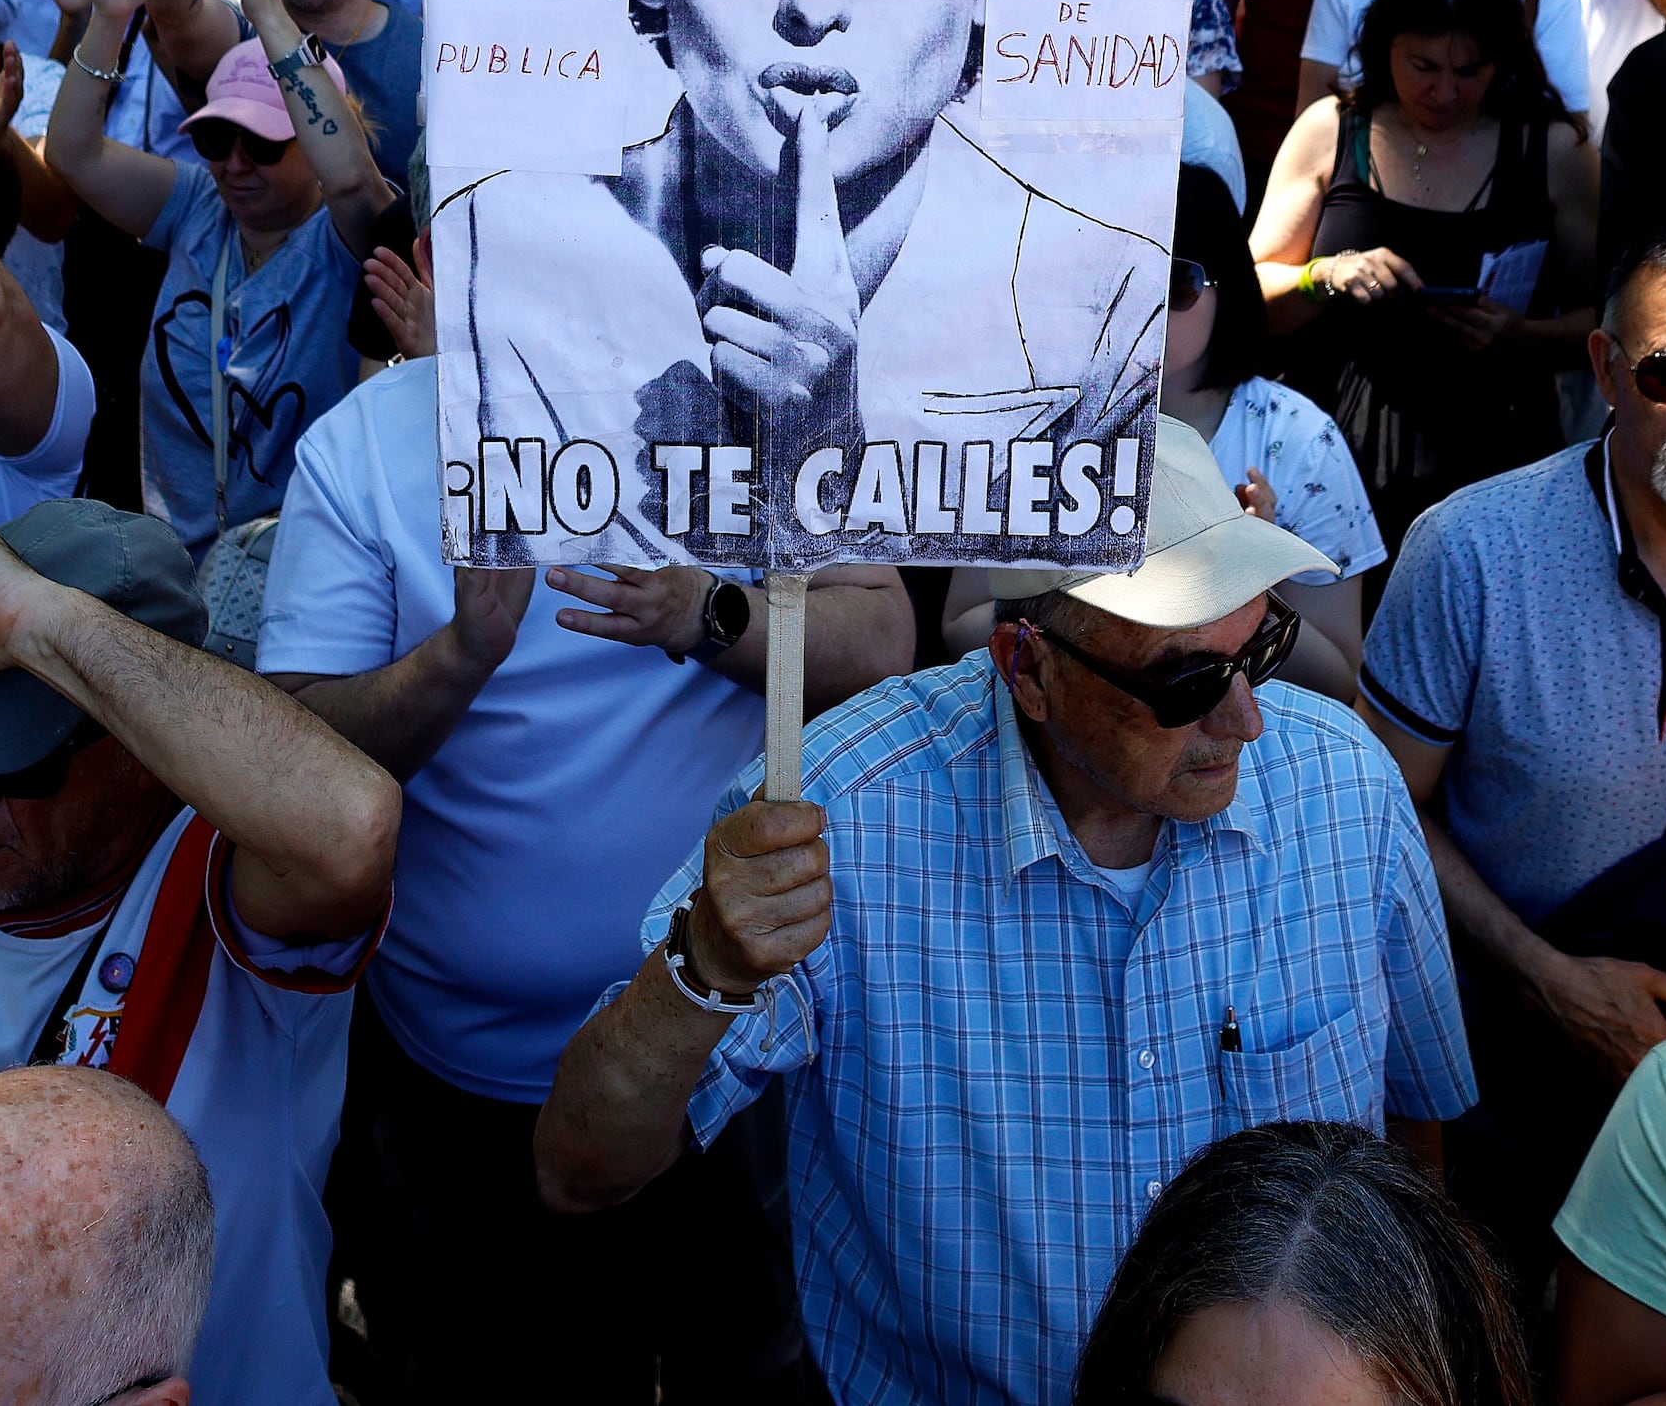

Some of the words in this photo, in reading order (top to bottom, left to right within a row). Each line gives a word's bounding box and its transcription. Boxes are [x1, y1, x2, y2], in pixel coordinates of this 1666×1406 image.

[1059, 2, 1091, 23] DE
[436, 43, 602, 80] PUBLICA
[996, 32, 1181, 89] SANIDAD
[649, 441, 758, 537] TE
[794, 437, 1141, 537] CALLES!
